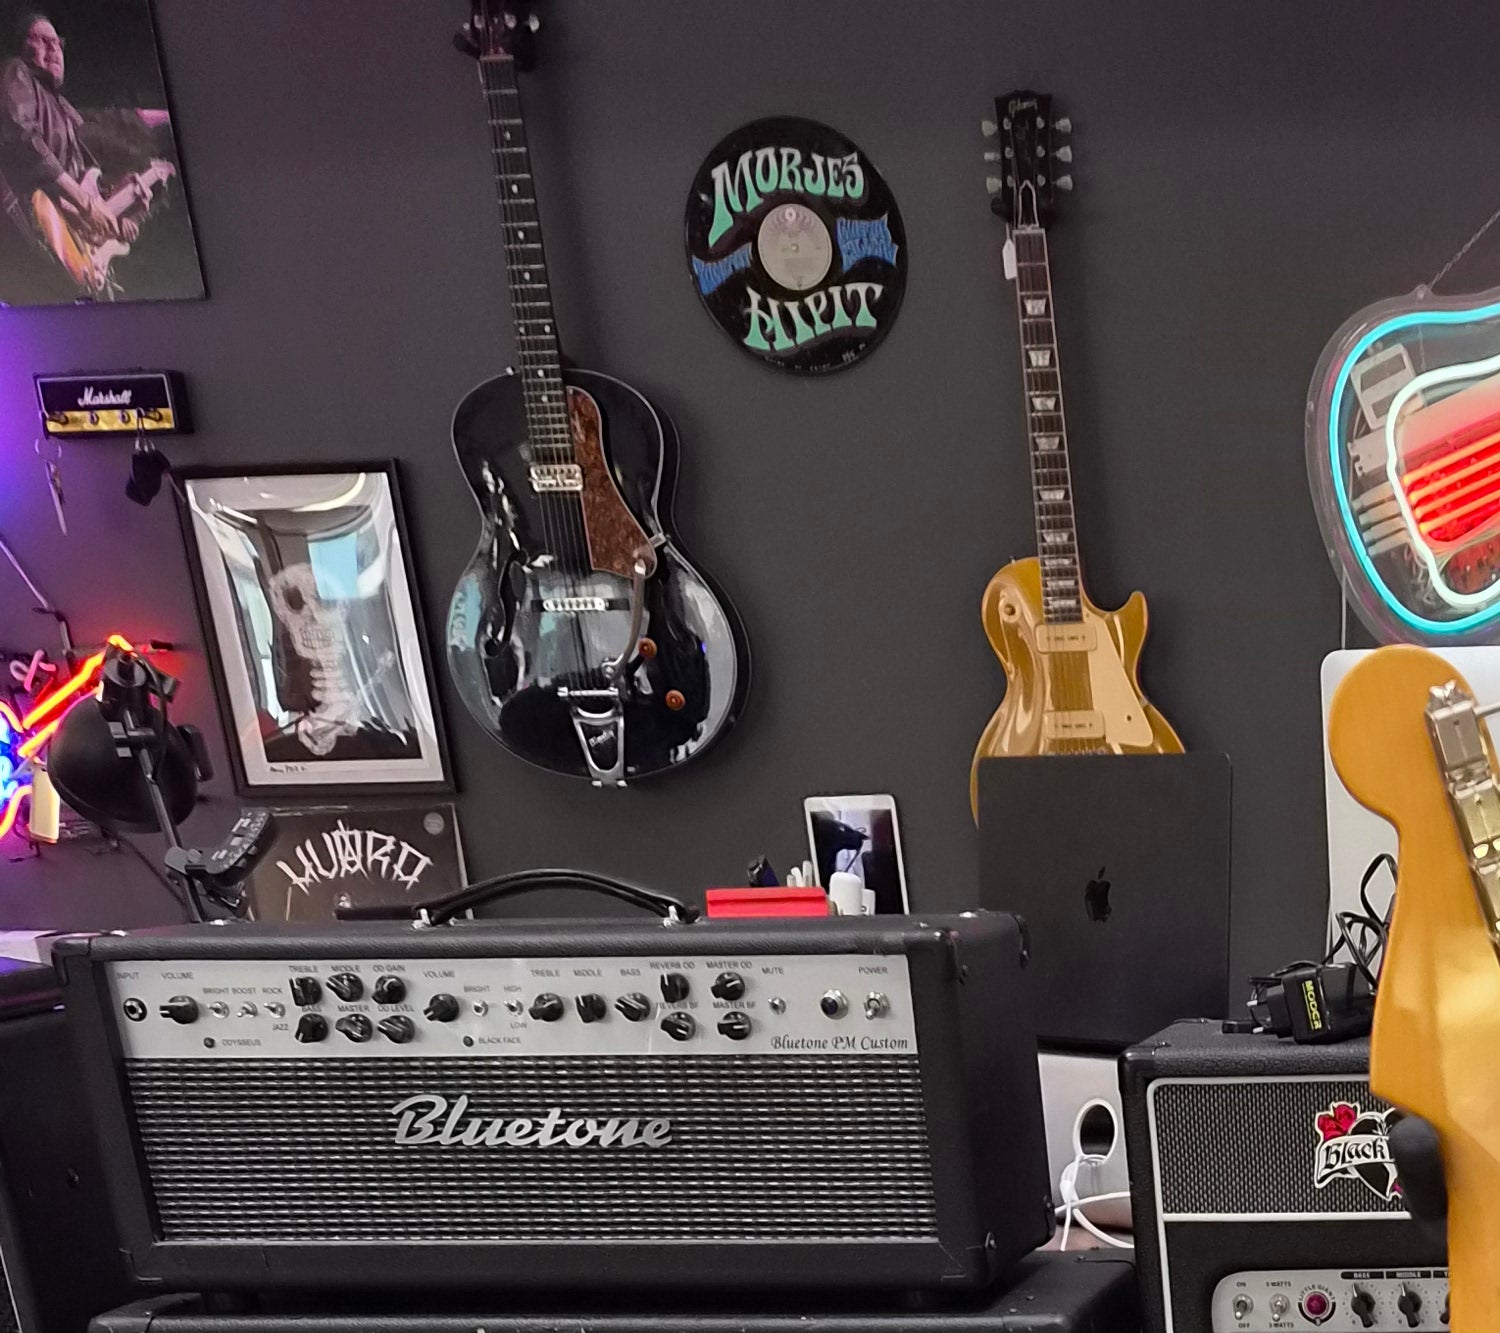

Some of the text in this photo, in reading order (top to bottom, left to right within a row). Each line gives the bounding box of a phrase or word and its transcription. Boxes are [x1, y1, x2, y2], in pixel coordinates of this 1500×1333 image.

[708, 146, 865, 248] MORJES
[743, 282, 883, 351] HIPIT
[77, 386, 132, 407] Marshall
[288, 965, 318, 973] TREBLE
[331, 965, 361, 973] MIDDLE
[650, 961, 681, 969] REVERB
[706, 961, 739, 969] MASTER
[423, 970, 455, 978] VOLUME
[531, 969, 560, 977] TREBLE
[573, 969, 602, 977] MIDDLE
[620, 968, 640, 976] BASS
[762, 967, 784, 975] MUTE
[858, 966, 888, 974] POWER
[116, 972, 139, 980] INPUT
[161, 972, 194, 980] VOLUME
[464, 985, 490, 993] BRIGHT
[504, 985, 522, 993] HIGH
[390, 1004, 414, 1012] LEVEL
[713, 1001, 746, 1009] MASTER
[771, 1034, 908, 1050] Bluetone PM Custom
[391, 1094, 672, 1148] Bluetone
[1325, 1139, 1386, 1169] Black
